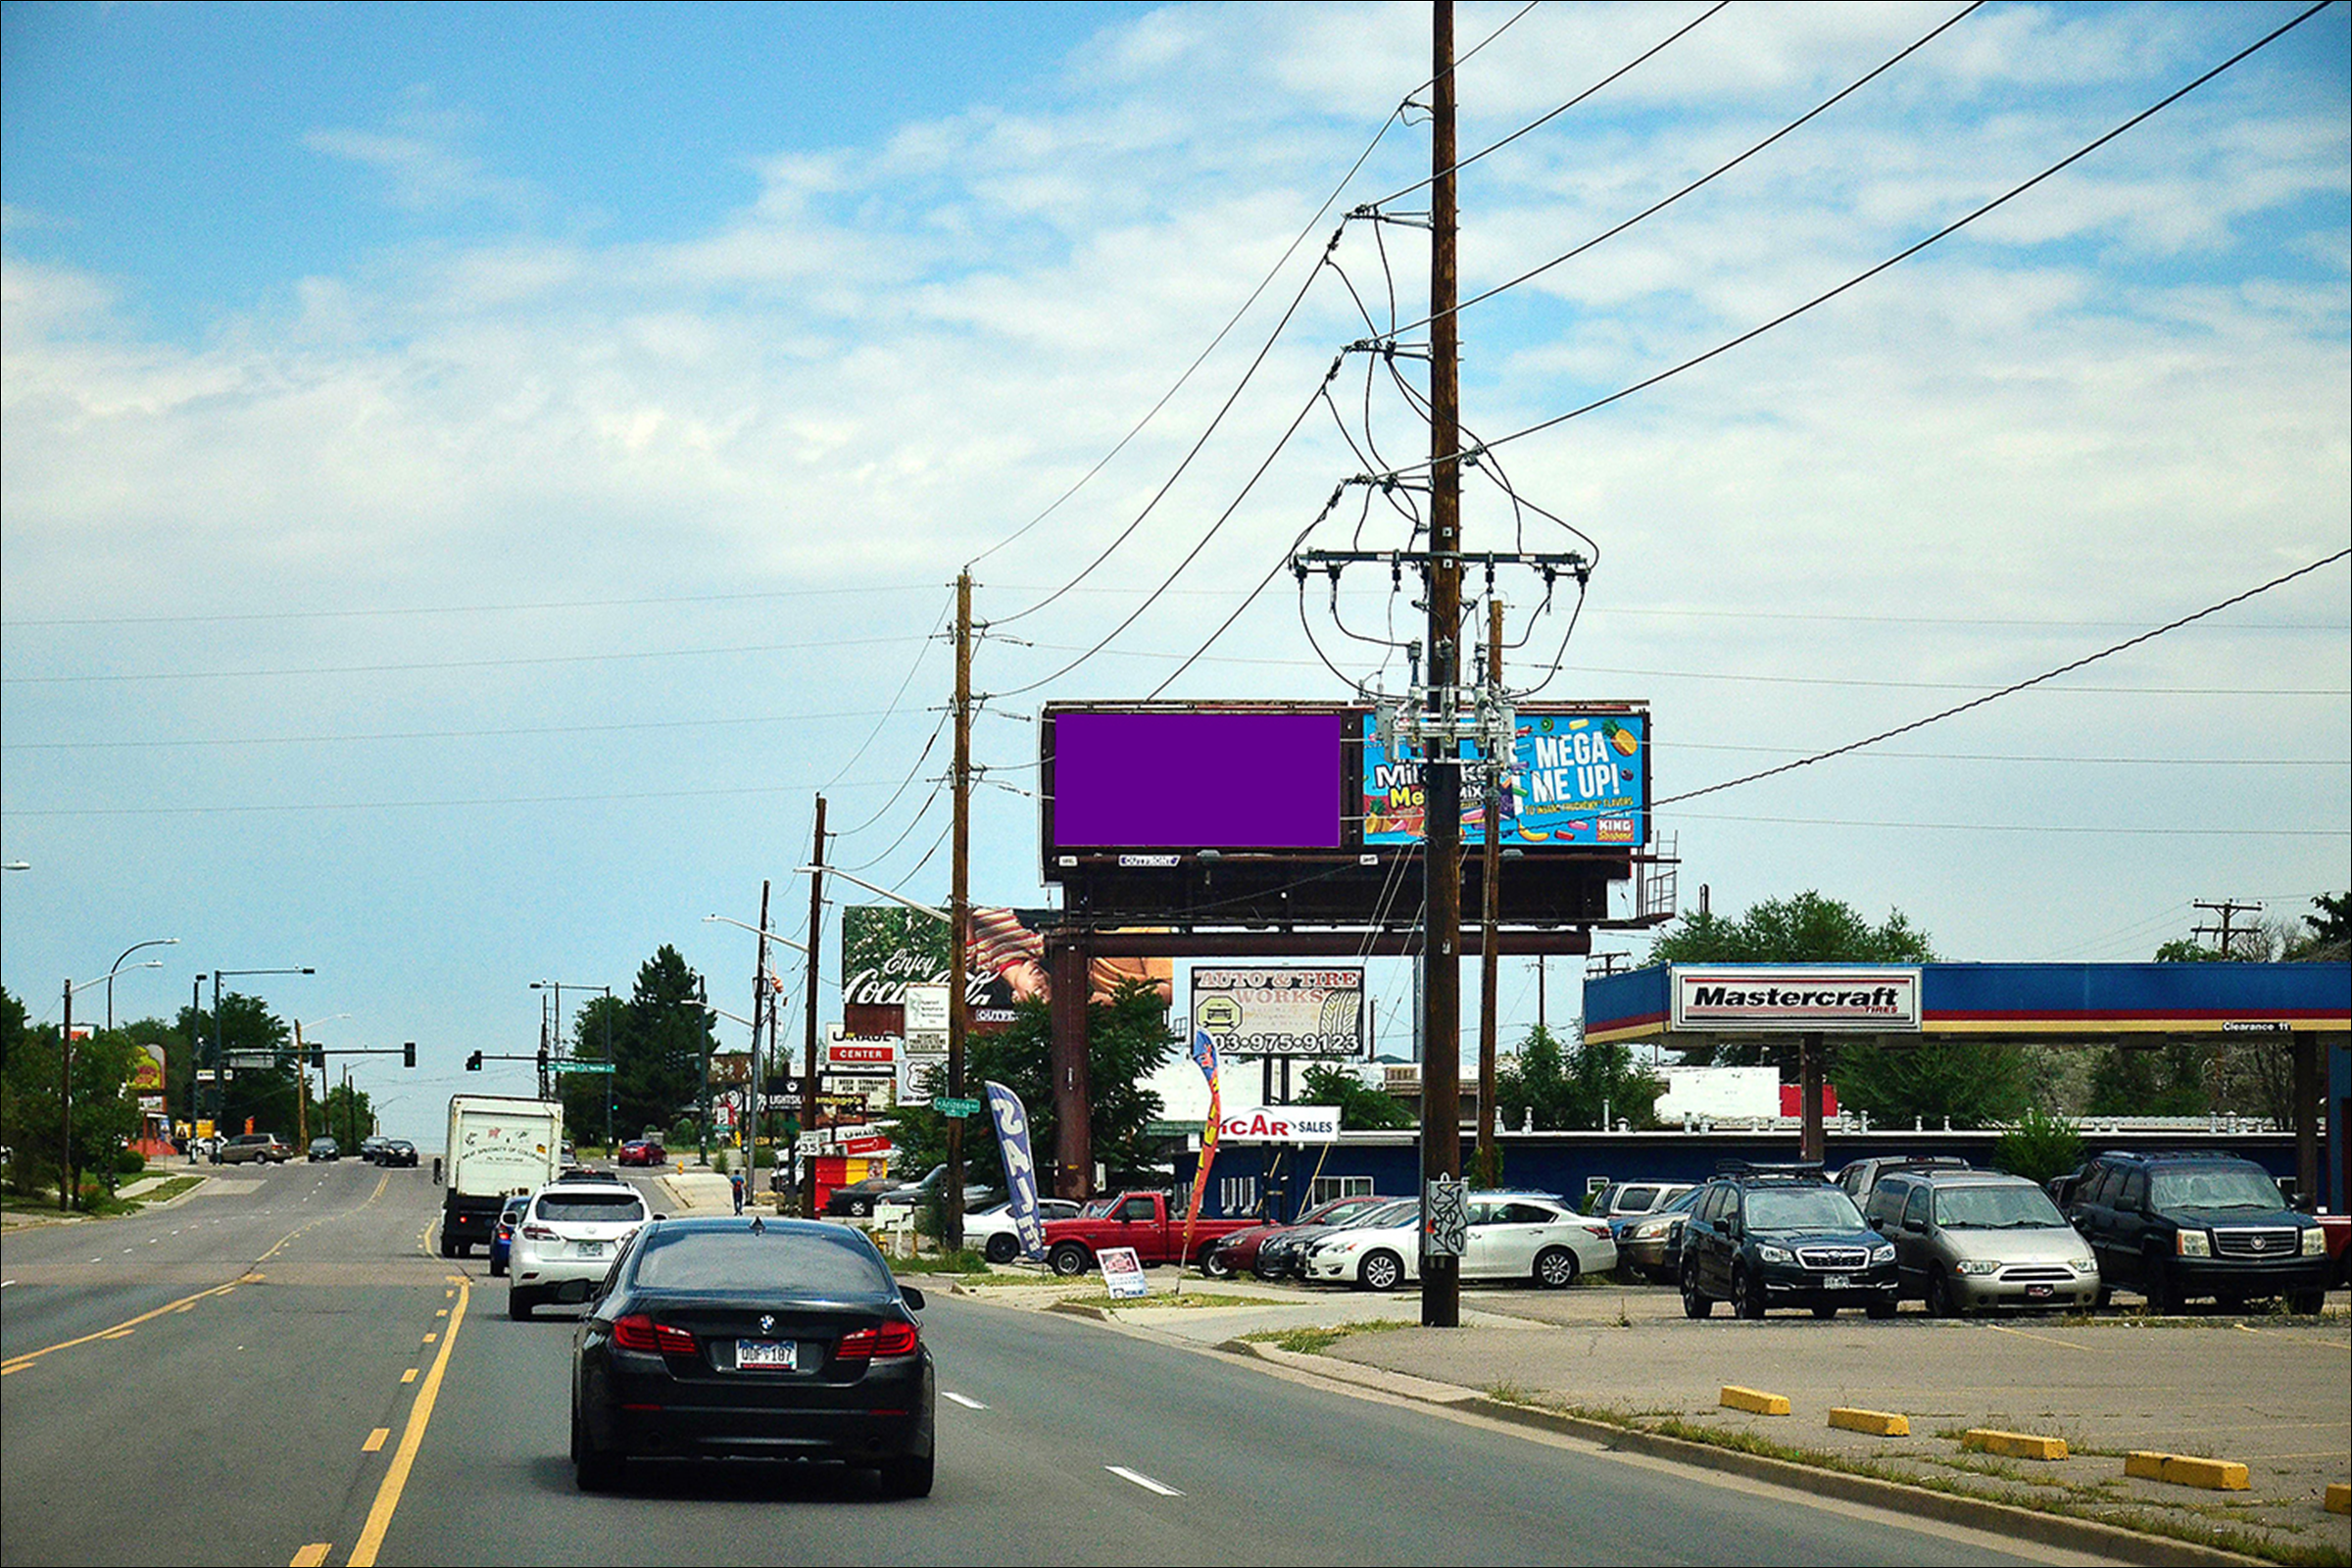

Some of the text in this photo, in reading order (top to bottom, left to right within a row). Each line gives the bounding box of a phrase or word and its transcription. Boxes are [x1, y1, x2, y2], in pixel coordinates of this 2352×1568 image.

[1535, 731, 1609, 769] MEGA
[1531, 763, 1620, 803] ME UP!
[1598, 819, 1632, 831] KING
[884, 948, 937, 978] Enjoy
[1199, 971, 1359, 988] AUTO & TIRE
[1236, 989, 1324, 1004] WORKS
[1693, 986, 1898, 1006] Mastercraft
[1864, 1005, 1898, 1014] TIRES
[2223, 1022, 2275, 1031] Clearance
[839, 1050, 882, 1059] CENTER
[1298, 1121, 1333, 1133] SALES
[801, 1143, 817, 1153] 35
